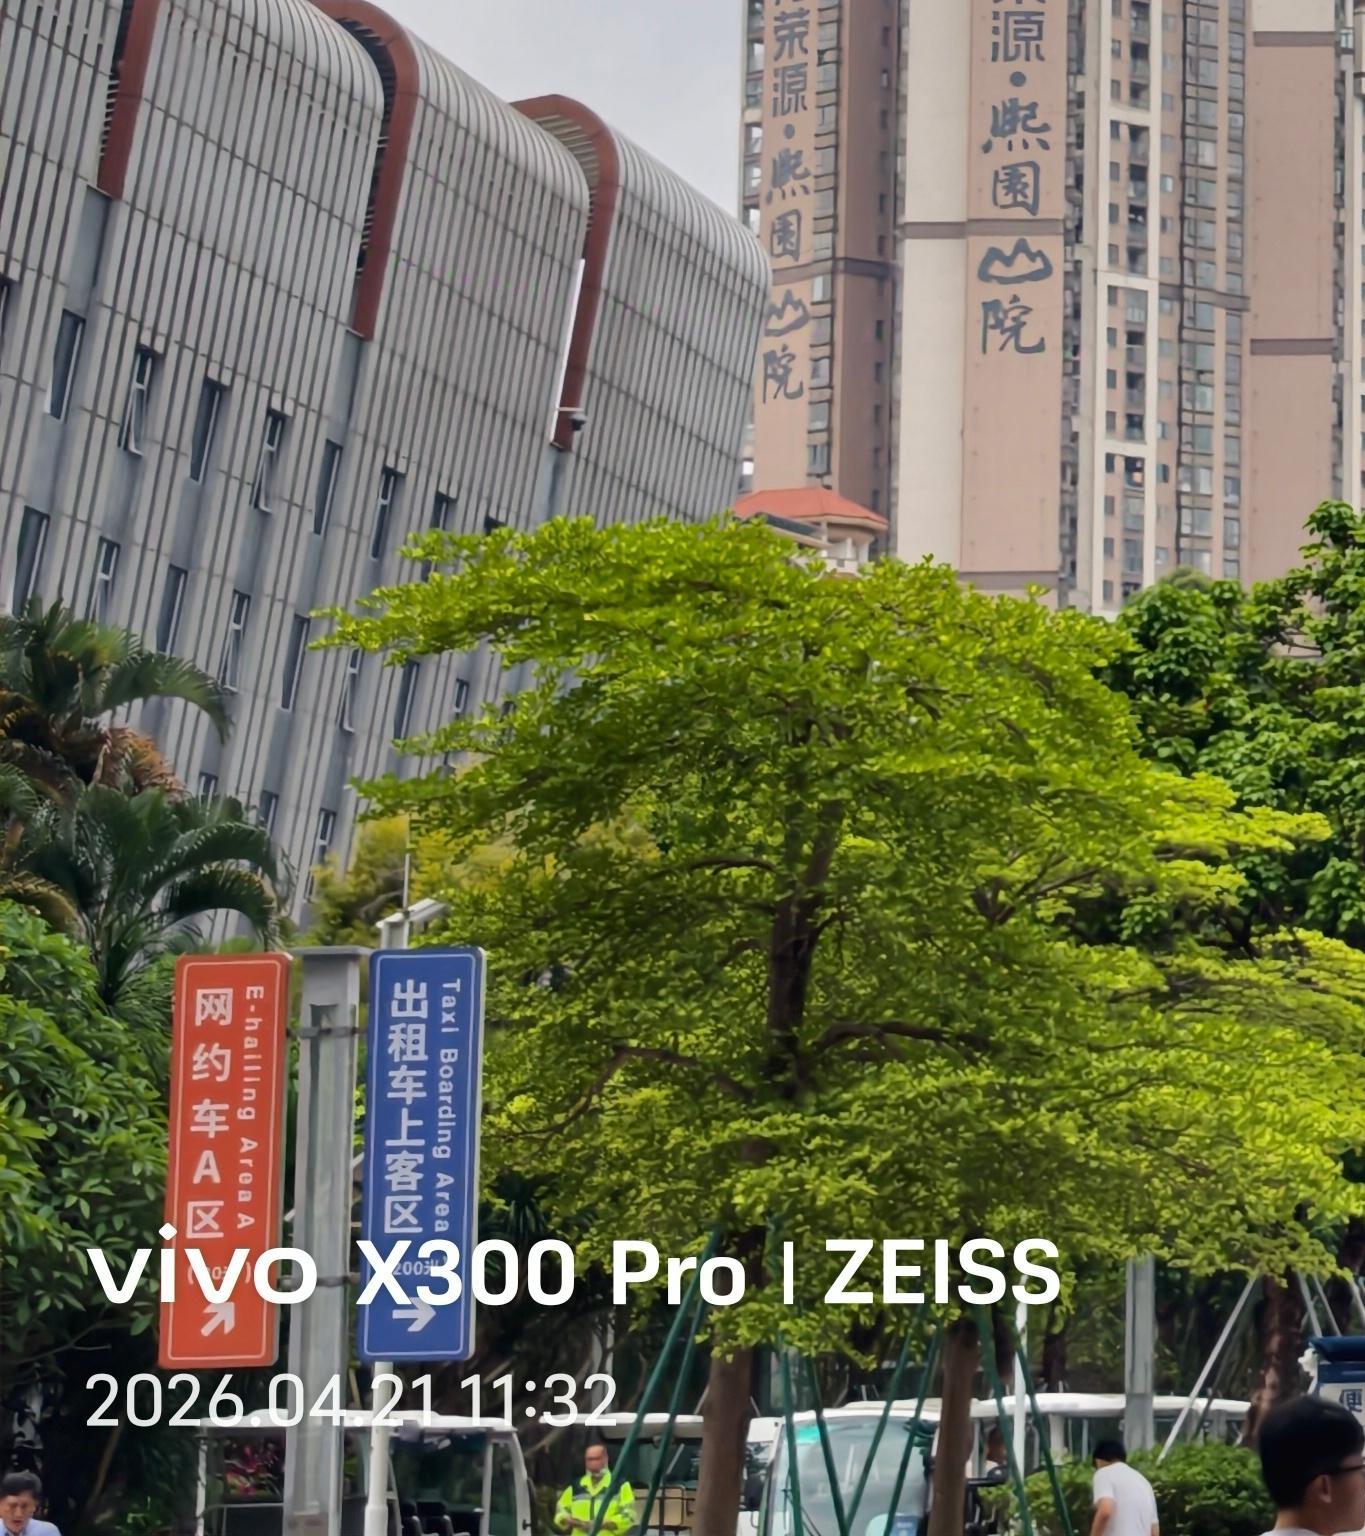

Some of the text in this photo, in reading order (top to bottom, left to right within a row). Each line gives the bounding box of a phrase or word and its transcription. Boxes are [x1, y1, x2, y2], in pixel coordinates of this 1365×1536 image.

[185, 987, 234, 1239] 网约车A区
[236, 985, 265, 1230] E-hailing Area A
[384, 978, 430, 1234] 出租车上客区
[432, 977, 462, 1233] Taxi Boarding Area
